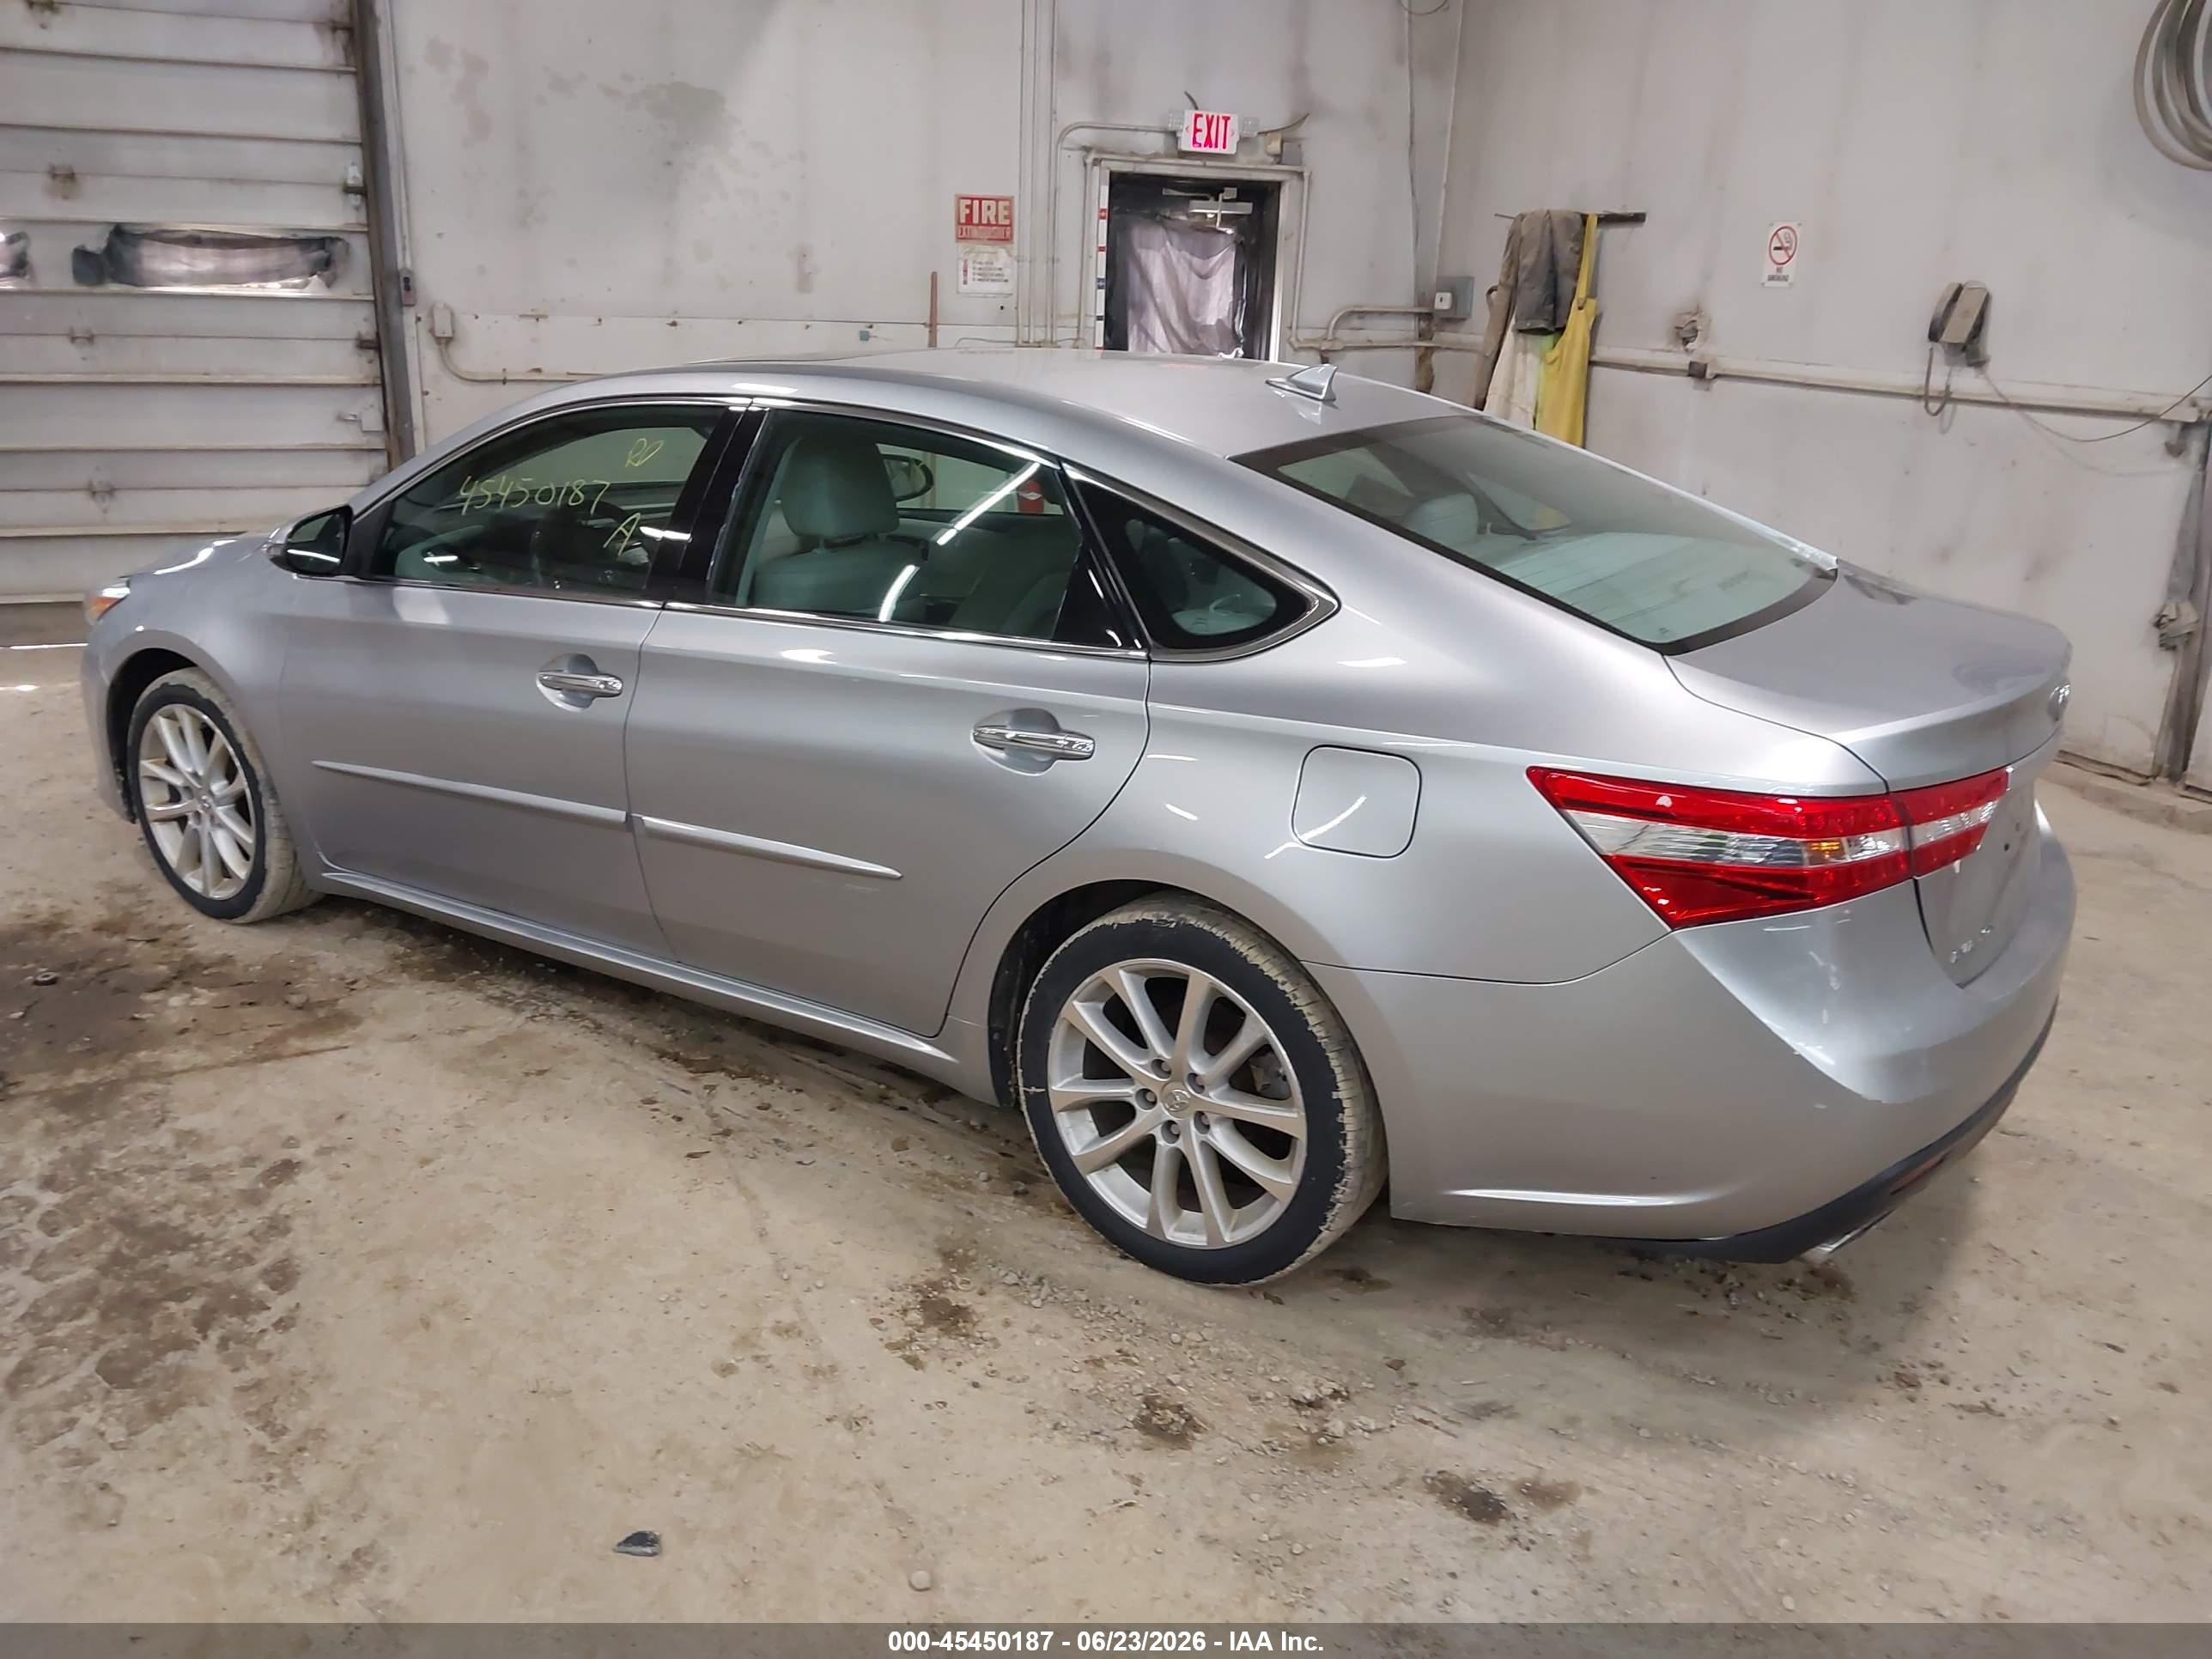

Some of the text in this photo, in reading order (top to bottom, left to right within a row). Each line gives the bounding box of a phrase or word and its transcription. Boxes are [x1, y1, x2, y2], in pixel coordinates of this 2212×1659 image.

[1192, 112, 1231, 149] EXIT
[959, 198, 1011, 225] FIRE
[459, 475, 611, 515] 45450187
